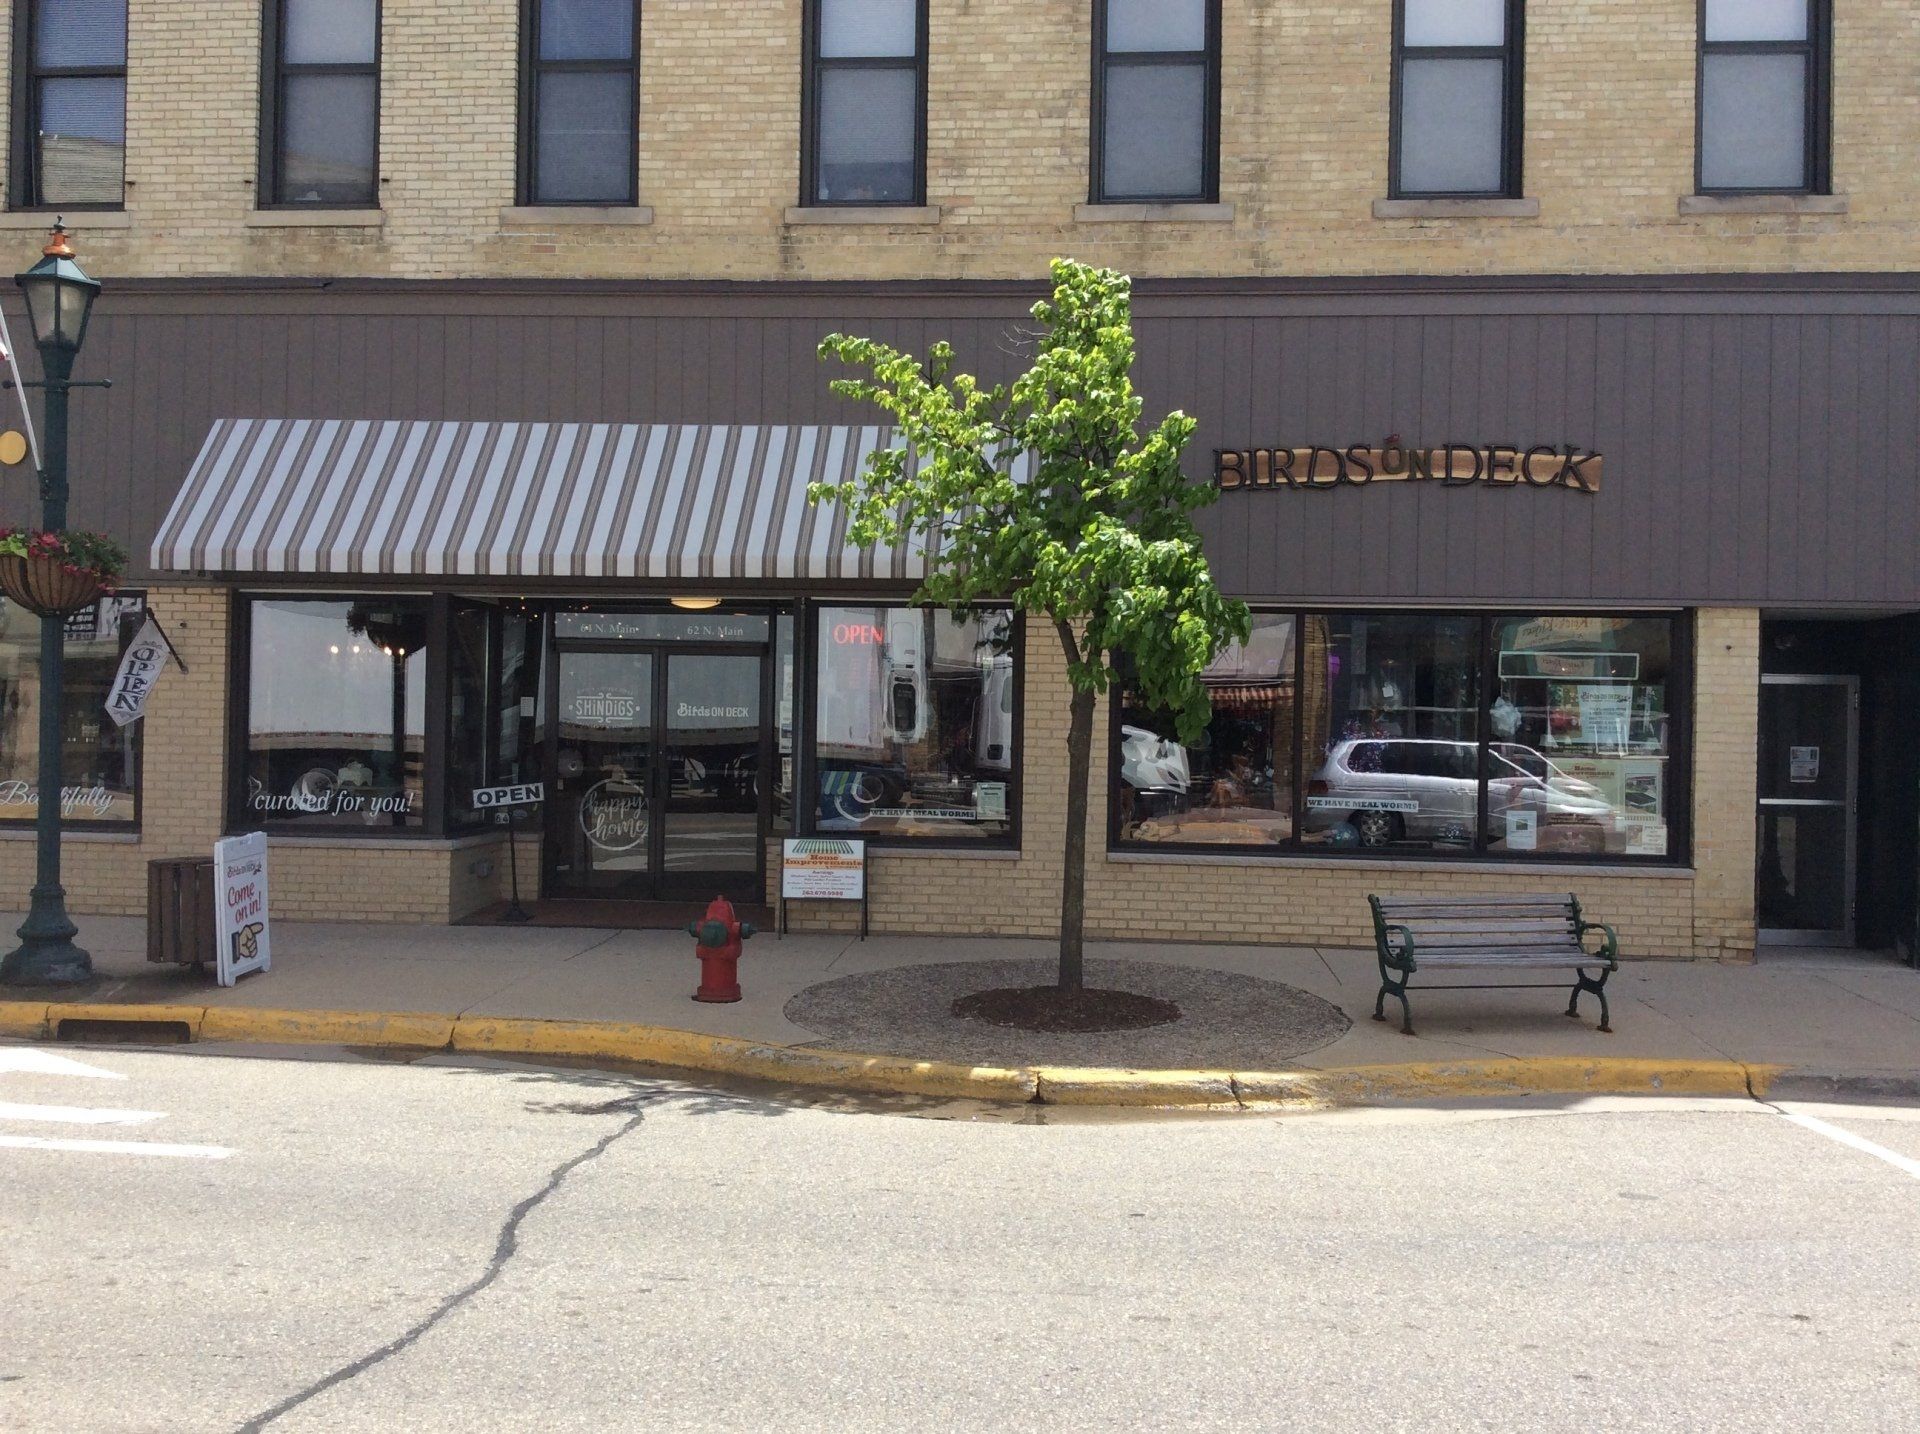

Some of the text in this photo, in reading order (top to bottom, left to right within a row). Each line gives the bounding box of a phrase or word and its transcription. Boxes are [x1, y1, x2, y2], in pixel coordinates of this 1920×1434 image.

[1213, 443, 1601, 493] BIRDS ON DECK
[609, 622, 636, 634] Main
[687, 625, 700, 635] 62
[717, 625, 744, 636] Main
[832, 623, 886, 646] OPEN
[112, 647, 161, 712] OPEN
[712, 706, 724, 717] ON
[726, 707, 750, 718] DECK
[254, 790, 415, 817] curated for you!
[476, 785, 540, 805] OPEN
[1380, 802, 1417, 810] WORMS
[228, 882, 255, 907] Come
[235, 891, 261, 923] on in!
